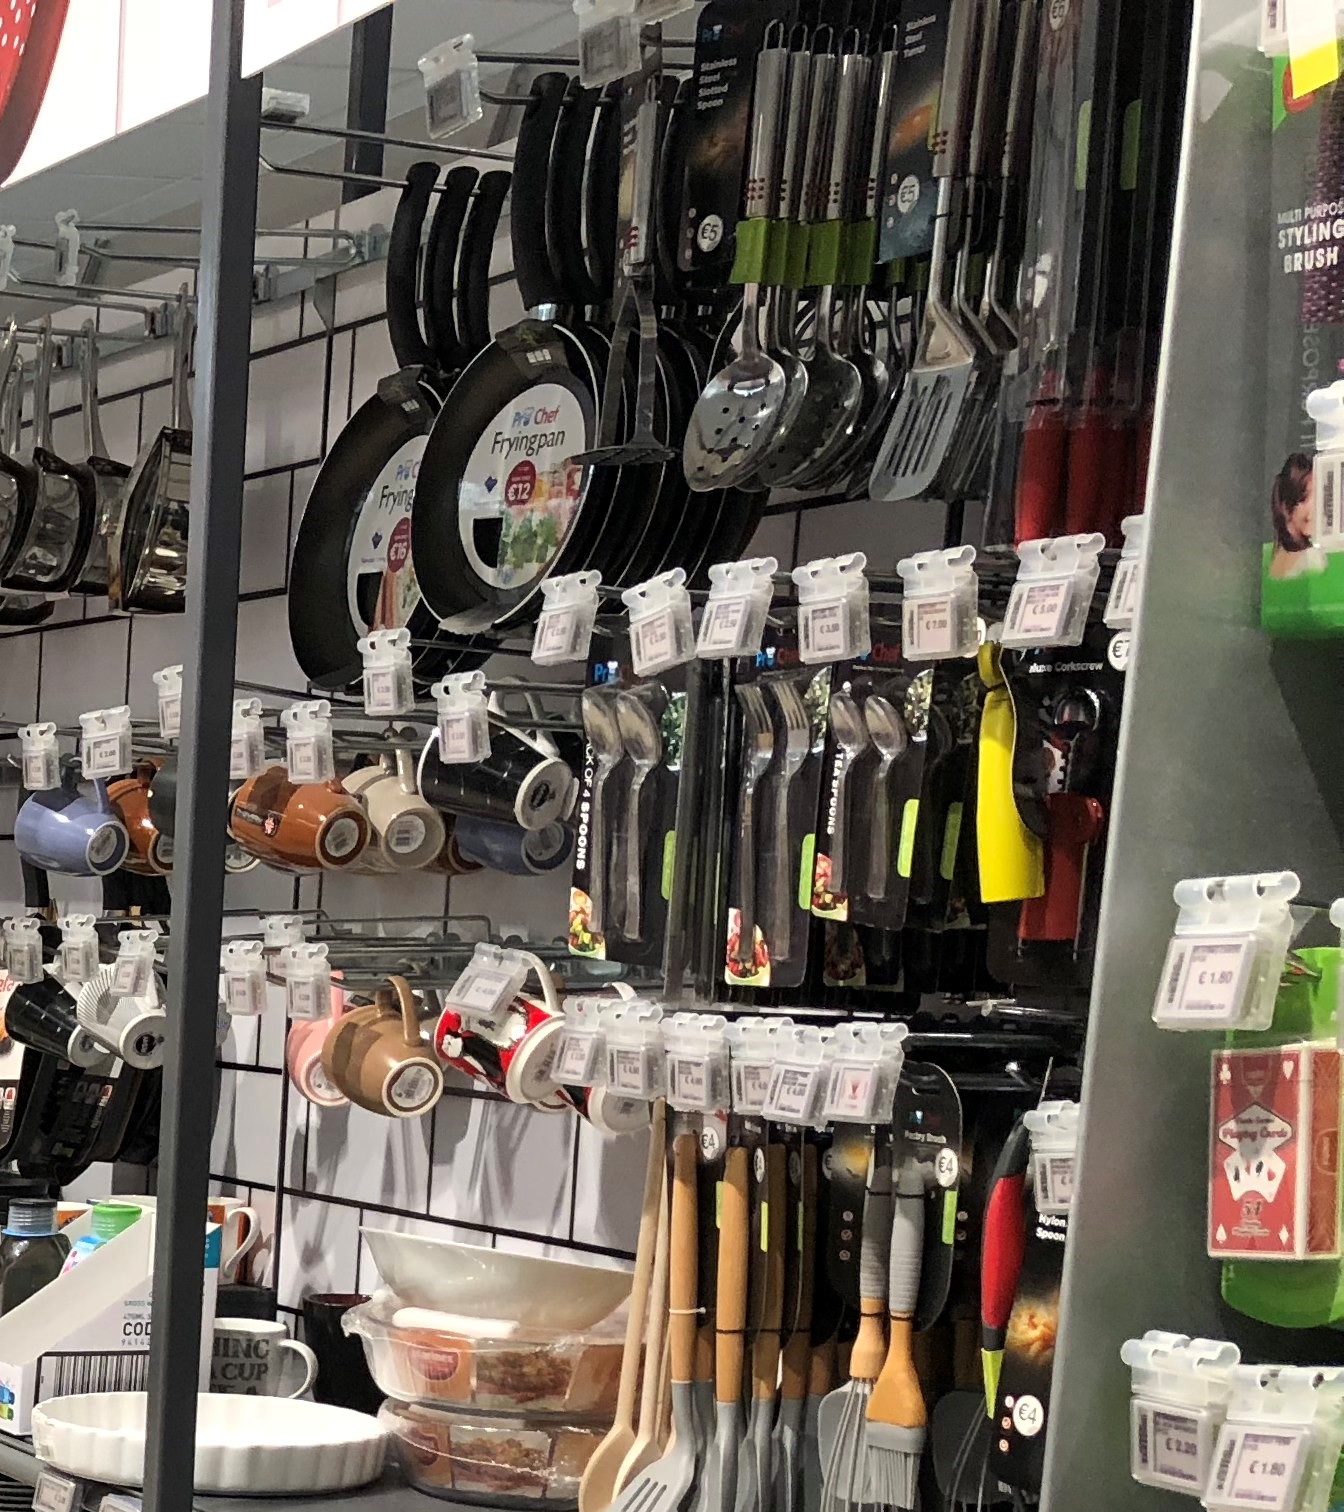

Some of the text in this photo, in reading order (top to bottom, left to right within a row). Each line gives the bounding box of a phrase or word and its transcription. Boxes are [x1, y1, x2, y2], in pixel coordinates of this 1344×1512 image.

[1277, 208, 1302, 224] MULTI
[701, 224, 718, 242] €5
[1278, 219, 1344, 250] STYLING
[1283, 246, 1339, 274] BRUSH
[534, 405, 560, 426] Chef
[379, 485, 414, 515] Frying
[508, 484, 530, 501] €12
[1055, 662, 1104, 672] Corkscrew
[584, 789, 591, 798] 4
[576, 801, 590, 870] SPOONS
[939, 1157, 954, 1172] €4
[1038, 1213, 1066, 1229] Nylon
[1036, 1227, 1065, 1241] Spoon
[221, 1363, 269, 1381] CUP
[1018, 1405, 1039, 1427] €4
